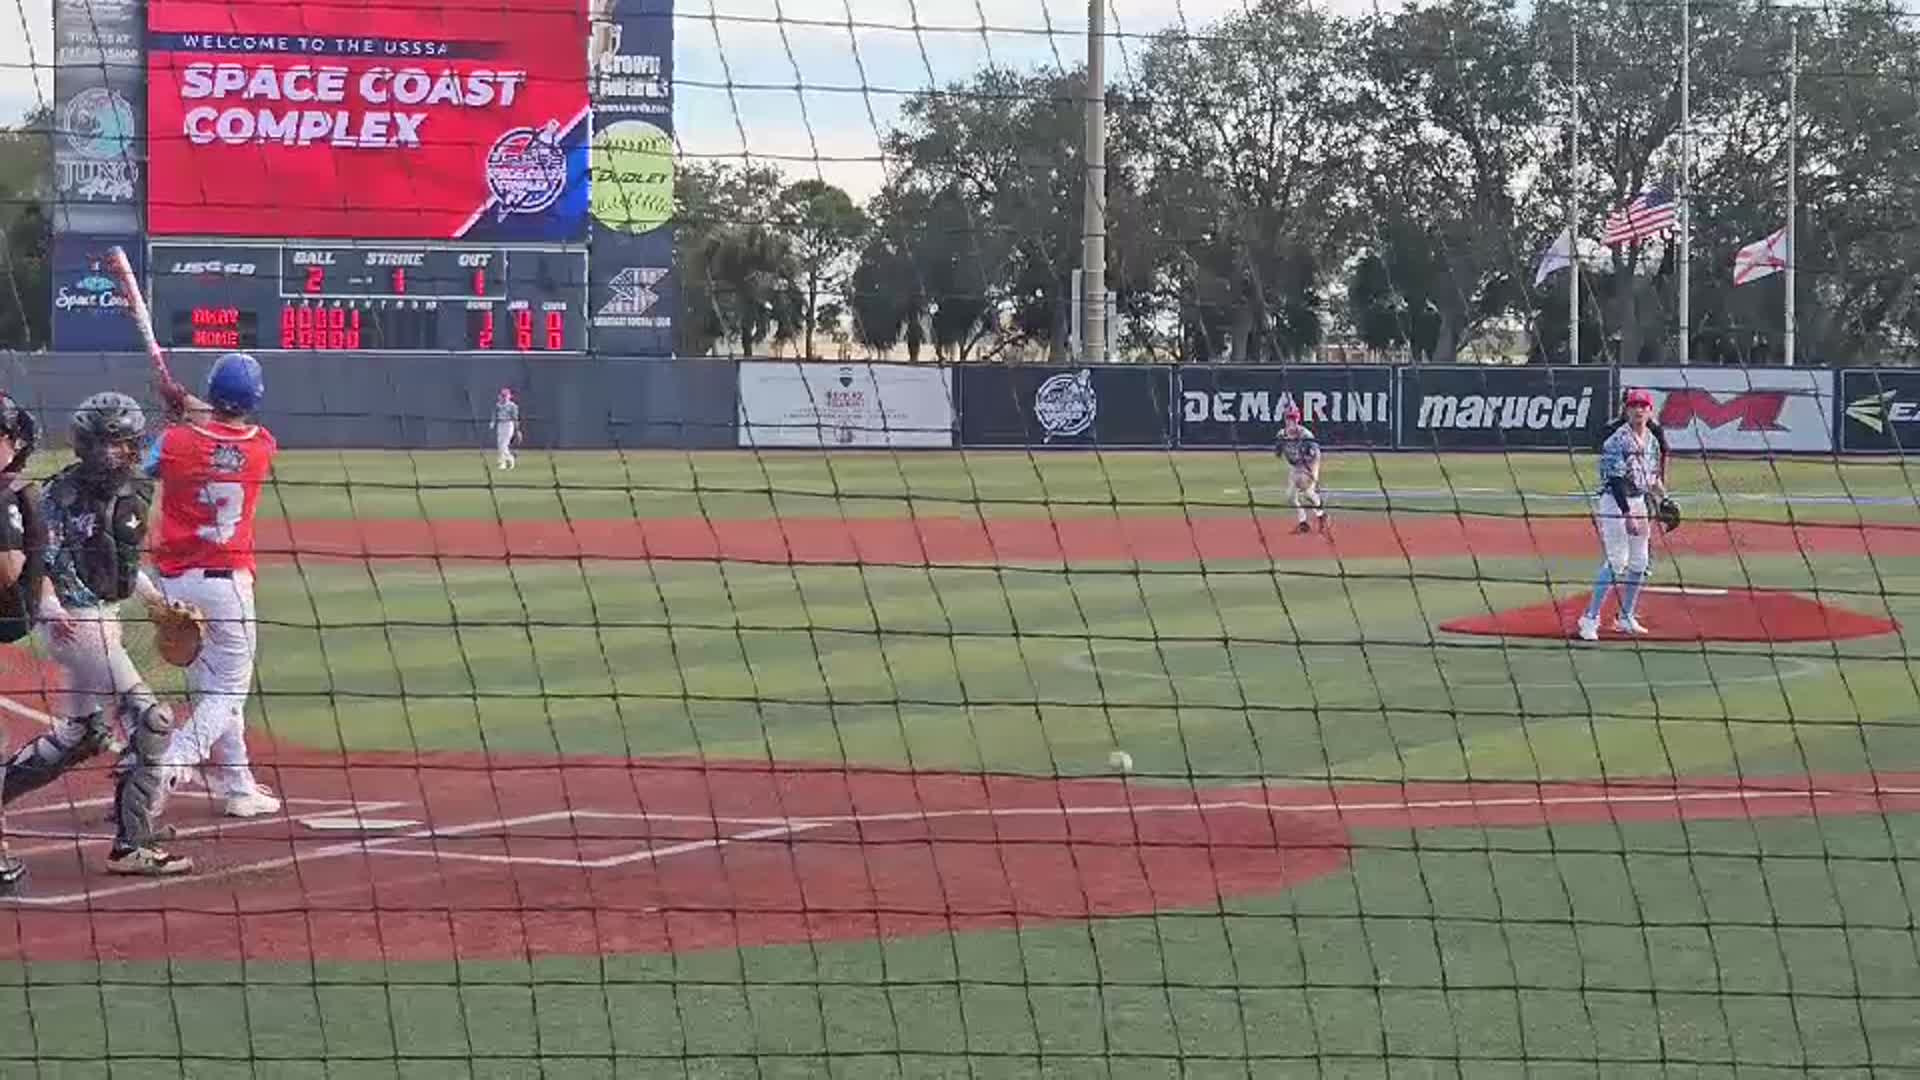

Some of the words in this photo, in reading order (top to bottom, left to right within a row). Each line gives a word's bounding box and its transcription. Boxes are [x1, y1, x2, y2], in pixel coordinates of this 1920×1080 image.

[183, 34, 290, 51] WELCOME
[300, 37, 323, 52] TO
[336, 38, 374, 53] THE
[384, 41, 449, 55] USSSA
[181, 62, 349, 102] SPACE
[360, 66, 527, 107] COAST
[184, 106, 428, 147] COMPLEX
[597, 169, 669, 184] DUDLEY
[293, 252, 336, 264] BALL
[365, 253, 424, 265] STRIKE
[458, 254, 492, 266] OUT
[305, 267, 325, 292] 2
[392, 267, 407, 294] 1
[474, 269, 486, 295] 1
[1183, 391, 1388, 422] DEMARINI
[1417, 386, 1593, 428] marucci
